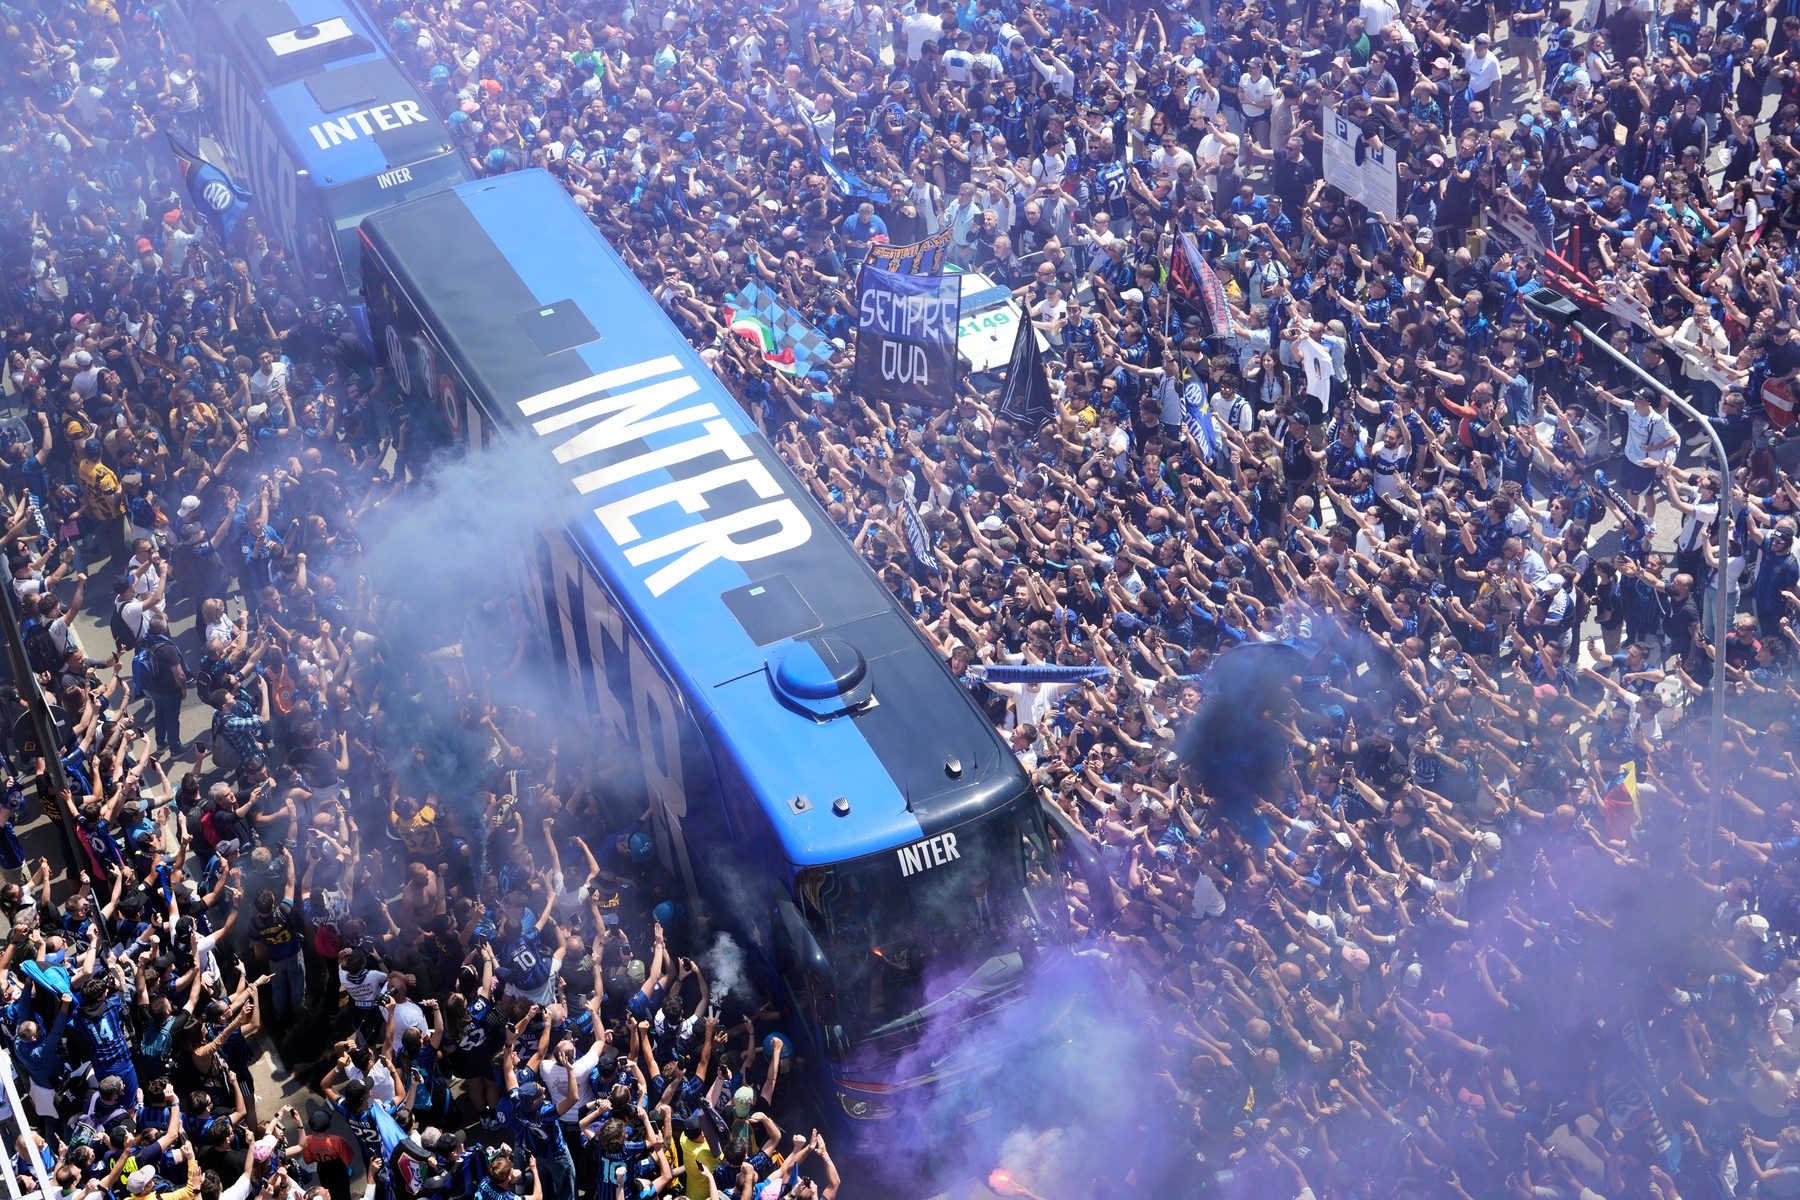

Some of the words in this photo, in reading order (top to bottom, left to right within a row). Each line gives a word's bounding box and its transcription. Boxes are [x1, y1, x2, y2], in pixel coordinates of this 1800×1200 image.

[309, 100, 429, 150] INTER
[1338, 121, 1346, 136] P
[377, 167, 413, 189] INTER
[1108, 176, 1127, 201] 22
[860, 289, 959, 339] SEMPRE
[959, 312, 1010, 338] 2149
[881, 340, 928, 386] QUA
[516, 354, 812, 598] INTER
[987, 668, 1020, 680] INTER
[1024, 668, 1053, 680] CLUB
[1056, 668, 1096, 680] NAPOLI
[896, 833, 961, 877] INTER
[513, 951, 536, 971] 10
[88, 1018, 114, 1045] 14
[601, 1157, 628, 1185] 10
